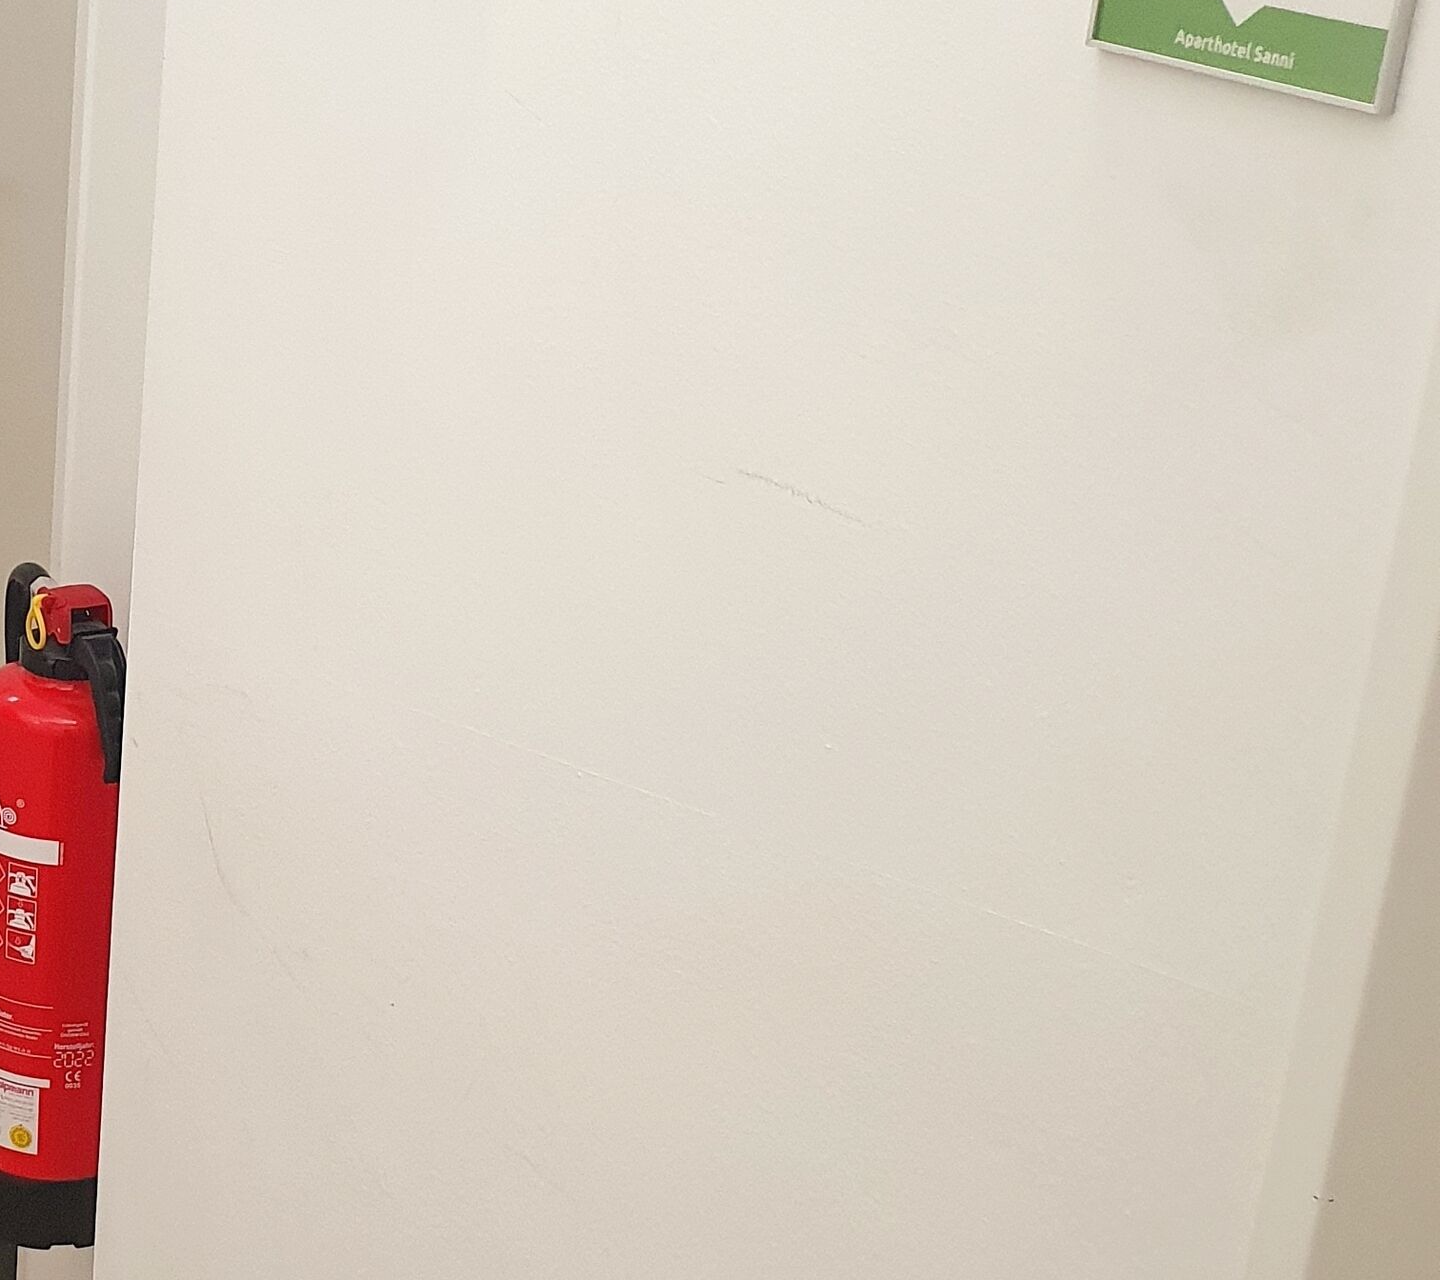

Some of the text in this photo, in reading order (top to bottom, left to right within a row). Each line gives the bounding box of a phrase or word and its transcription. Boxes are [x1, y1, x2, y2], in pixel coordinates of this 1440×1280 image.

[1174, 28, 1297, 70] Aparthotel Sanni
[53, 1050, 95, 1068] 2022
